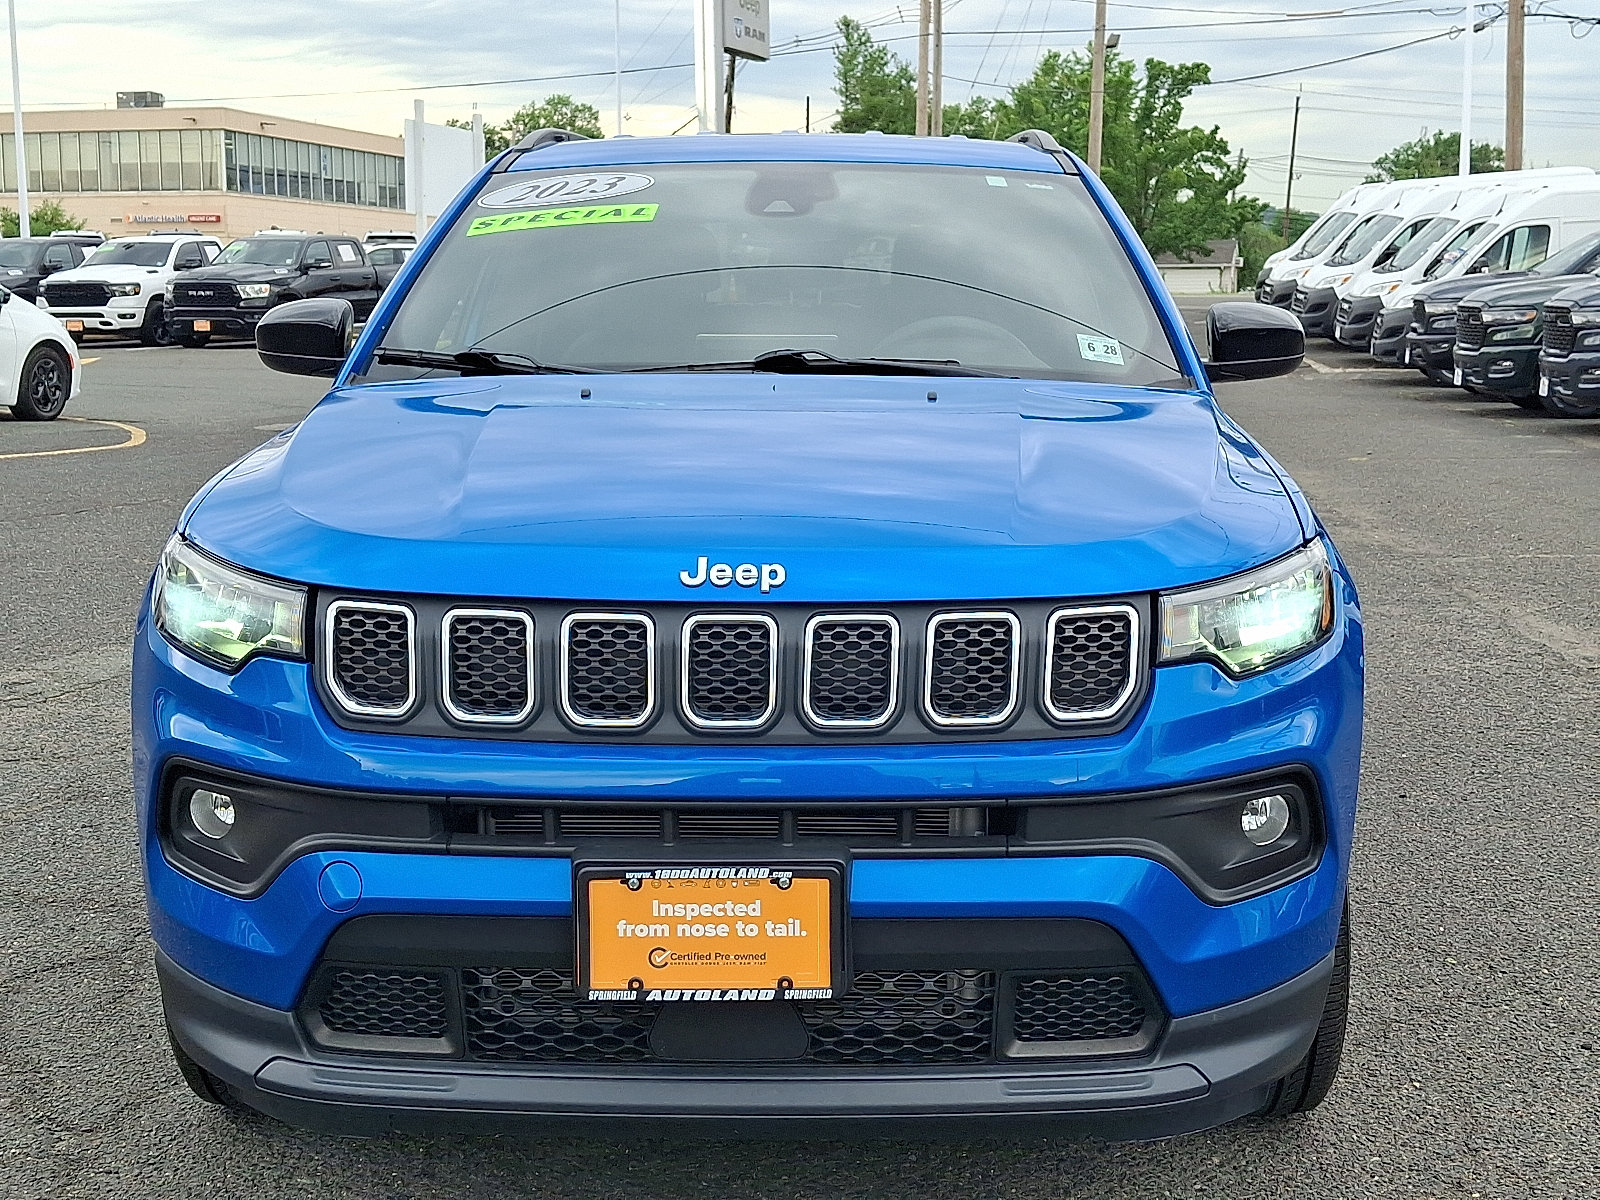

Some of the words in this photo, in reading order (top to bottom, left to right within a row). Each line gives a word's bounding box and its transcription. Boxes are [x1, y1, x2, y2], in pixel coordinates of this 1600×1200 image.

[744, 25, 766, 43] RAM
[503, 176, 627, 204] 2023
[133, 214, 160, 223] Atlantic
[161, 214, 186, 223] Health
[473, 207, 648, 230] SPECIAL
[1087, 342, 1096, 352] 6
[1103, 344, 1118, 356] 28
[679, 556, 787, 594] Jeep
[652, 899, 761, 921] Inspected
[616, 919, 670, 937] from
[676, 923, 730, 938] nose
[735, 920, 759, 937] to
[764, 917, 808, 937] tail.
[670, 952, 712, 961] Certified
[714, 952, 767, 961] Pre-owned
[588, 989, 638, 1001] SPRINGFIELD
[646, 988, 776, 1001] AUTOLAND
[784, 988, 833, 1000] SPRINGFIELD
